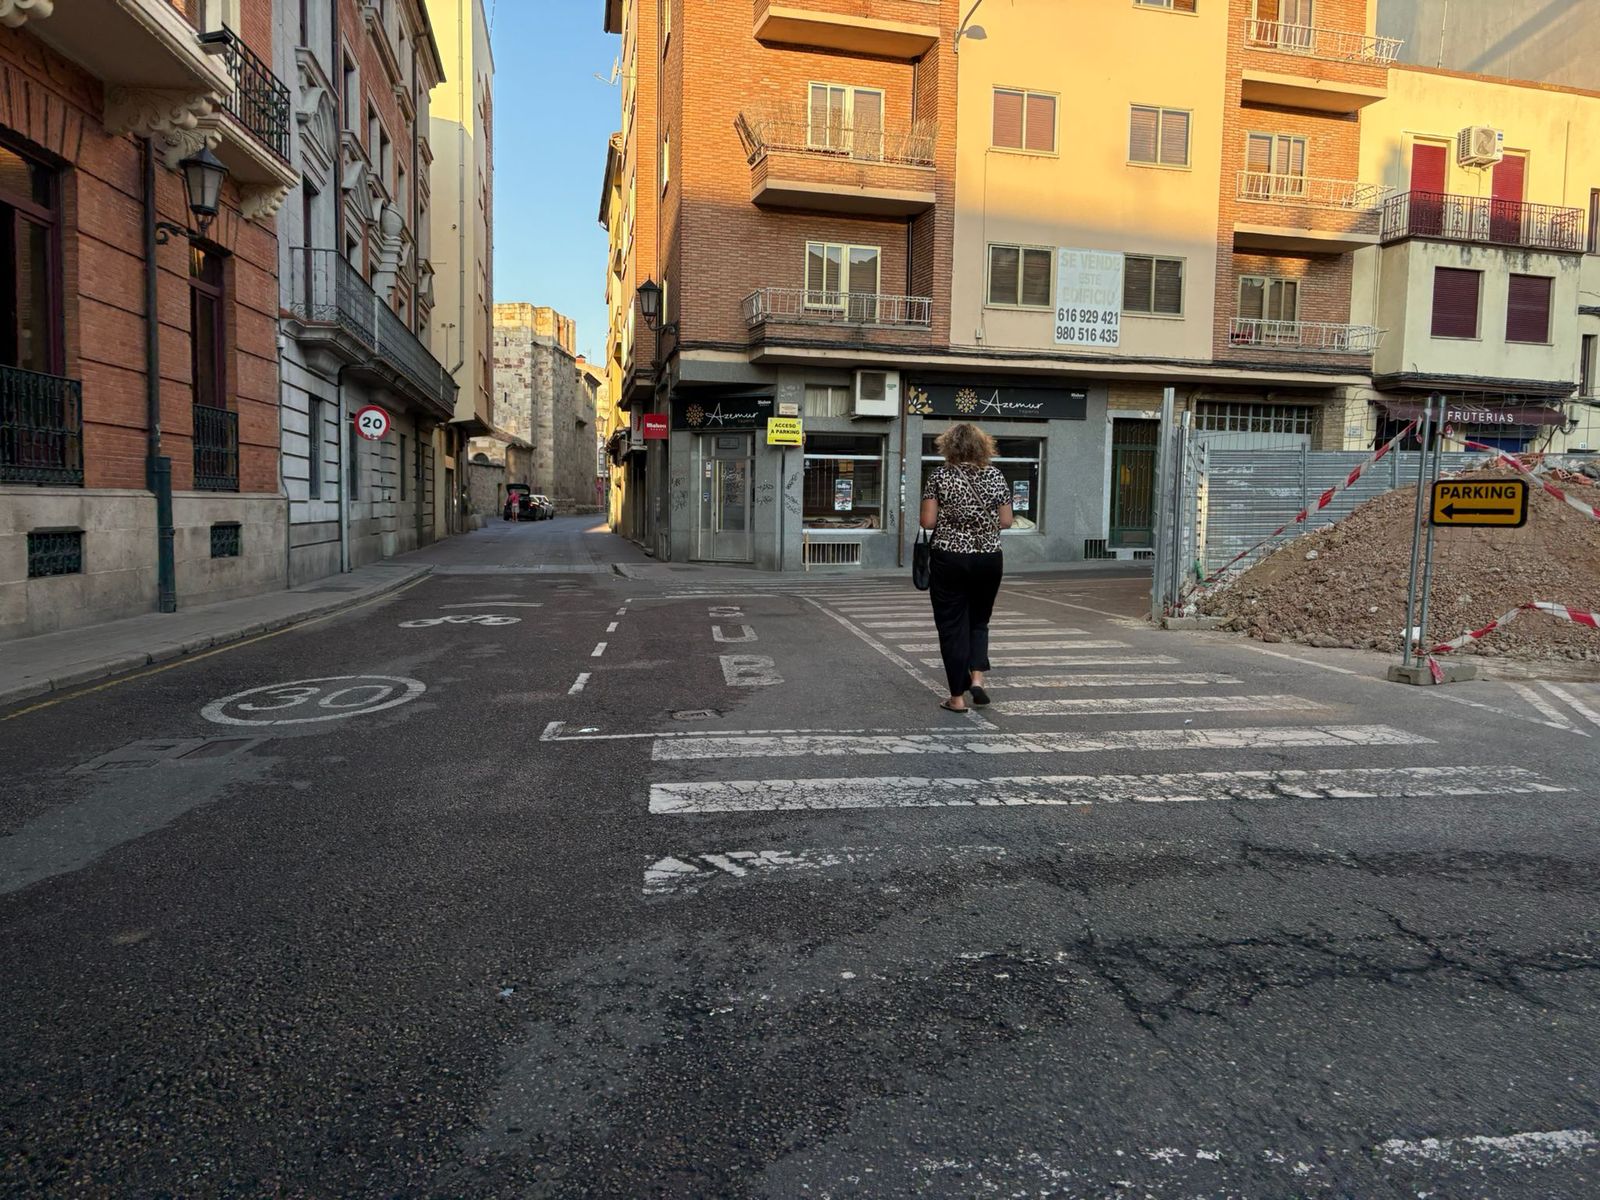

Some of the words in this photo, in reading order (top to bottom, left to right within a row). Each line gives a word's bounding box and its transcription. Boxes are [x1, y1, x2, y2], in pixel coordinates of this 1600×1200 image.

[1061, 252, 1077, 268] SE
[1081, 254, 1121, 271] VENDE
[1079, 273, 1102, 285] ESTE
[1063, 288, 1117, 305] EDIFICIO
[1058, 308, 1077, 322] 616
[1079, 309, 1099, 324] 929
[1101, 311, 1119, 325] 421
[1056, 326, 1075, 340] 980
[1078, 327, 1097, 342] 516
[1099, 329, 1118, 343] 435
[979, 388, 1044, 415] Azemur
[705, 402, 759, 426] Azemur
[1447, 411, 1514, 423] FRUTERIAS
[362, 416, 383, 430] 20
[1440, 486, 1516, 499] PARKING
[237, 685, 393, 711] 30
